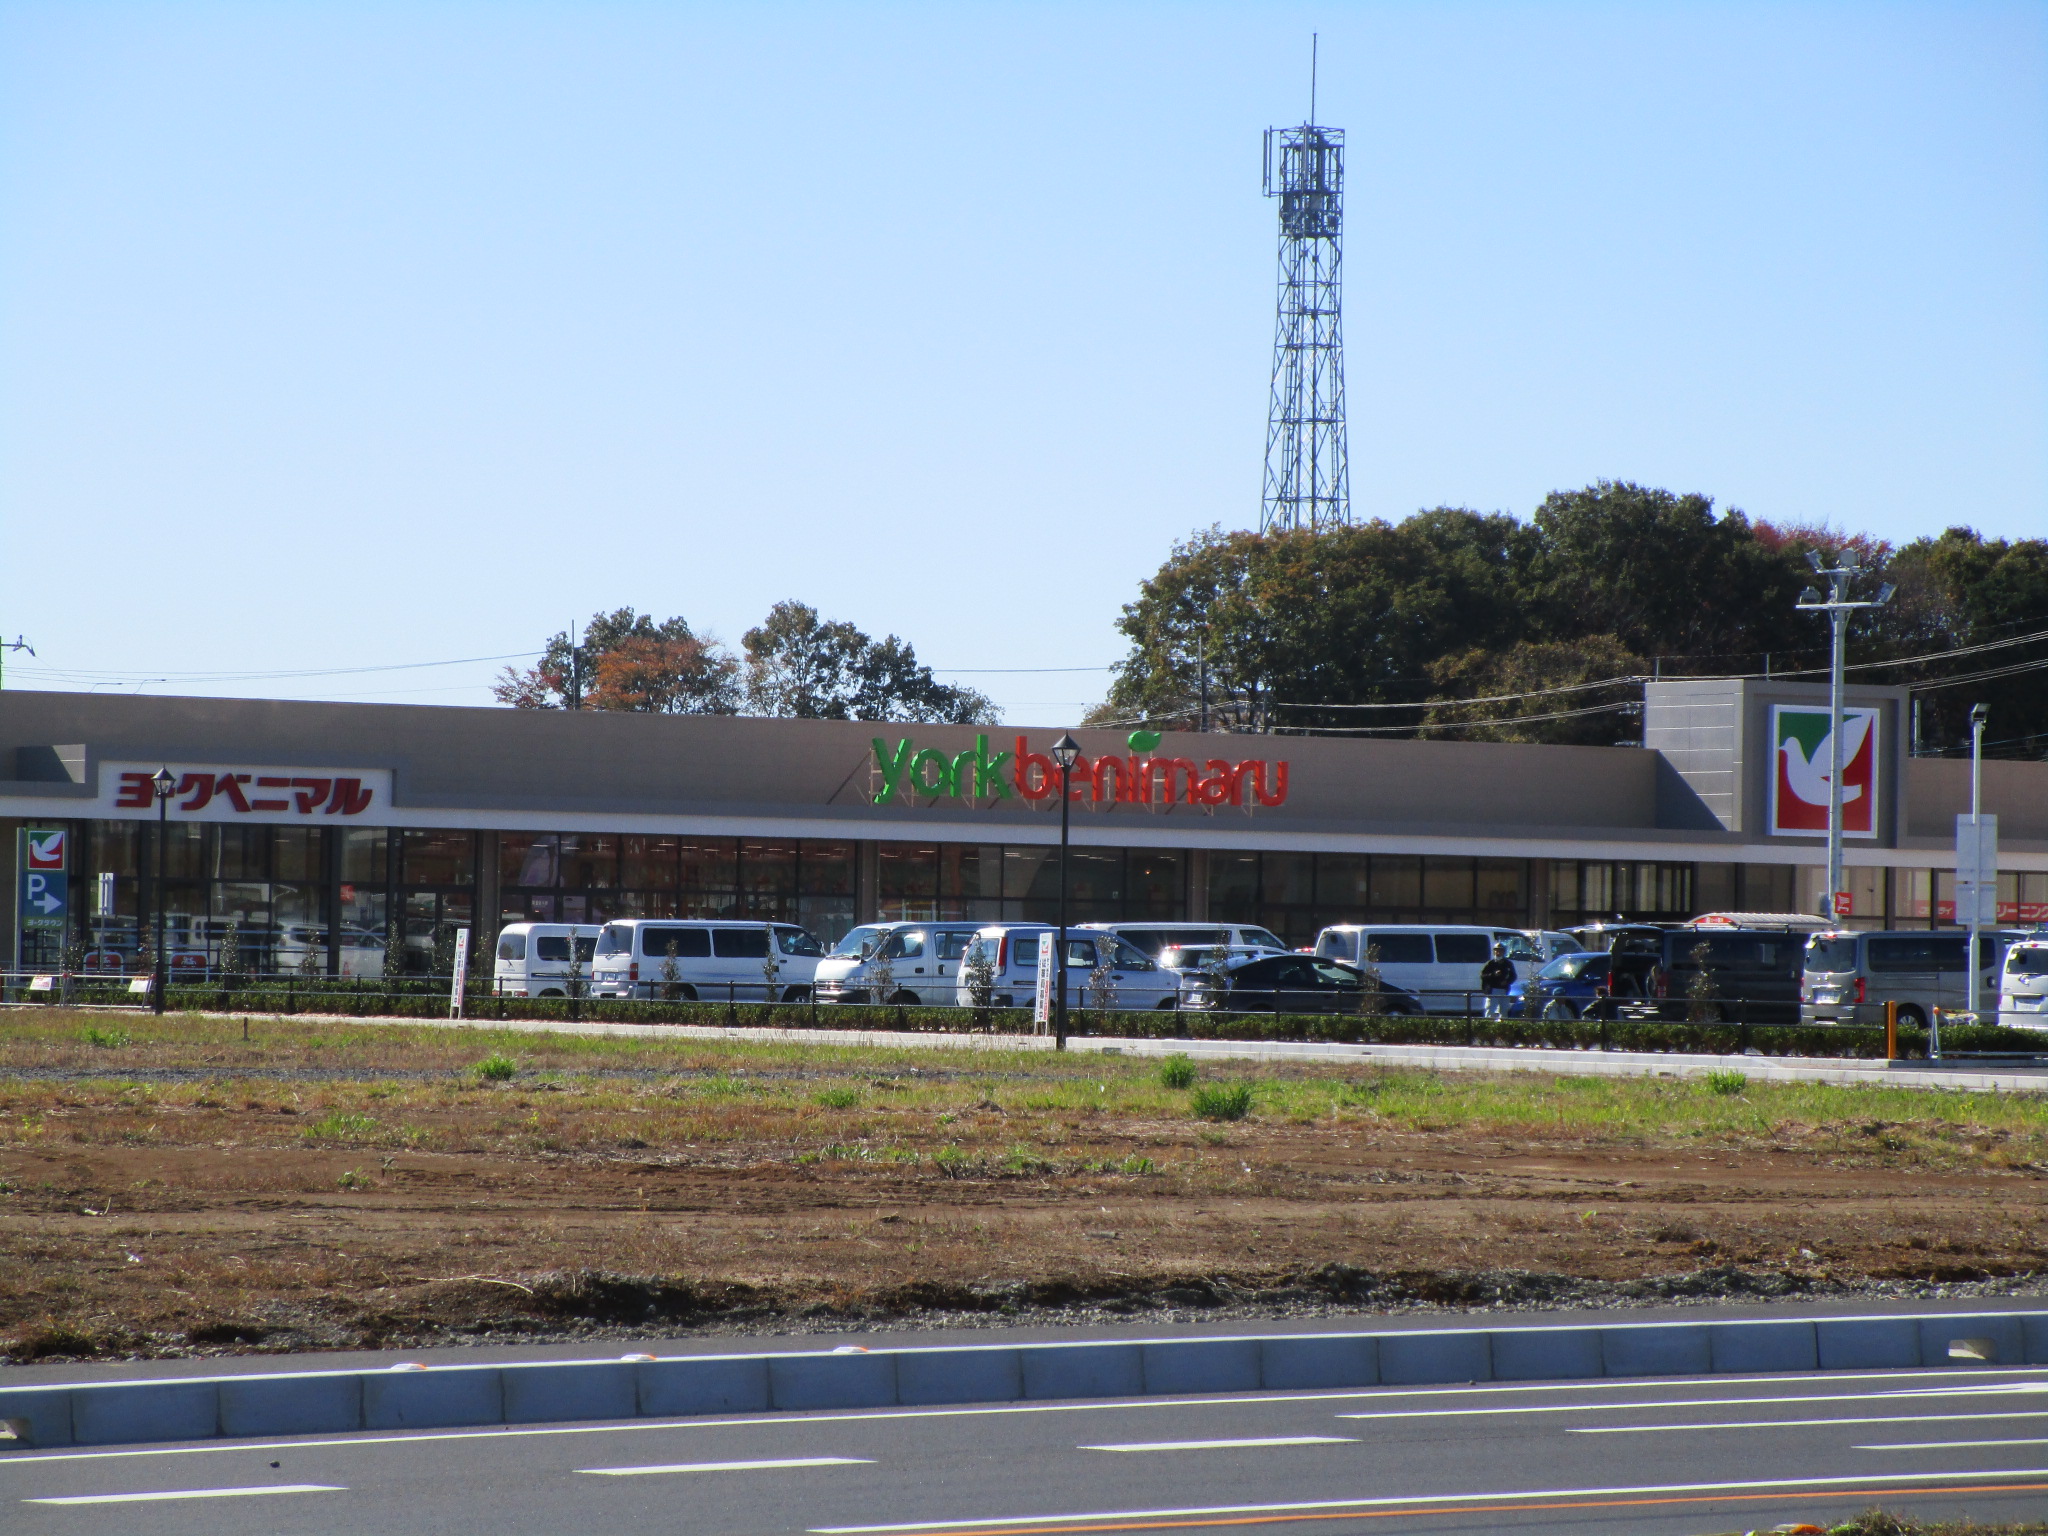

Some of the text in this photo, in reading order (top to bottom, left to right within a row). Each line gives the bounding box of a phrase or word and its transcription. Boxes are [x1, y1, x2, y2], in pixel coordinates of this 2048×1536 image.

[116, 772, 373, 815] ヨークベニマル
[27, 874, 46, 900] P
